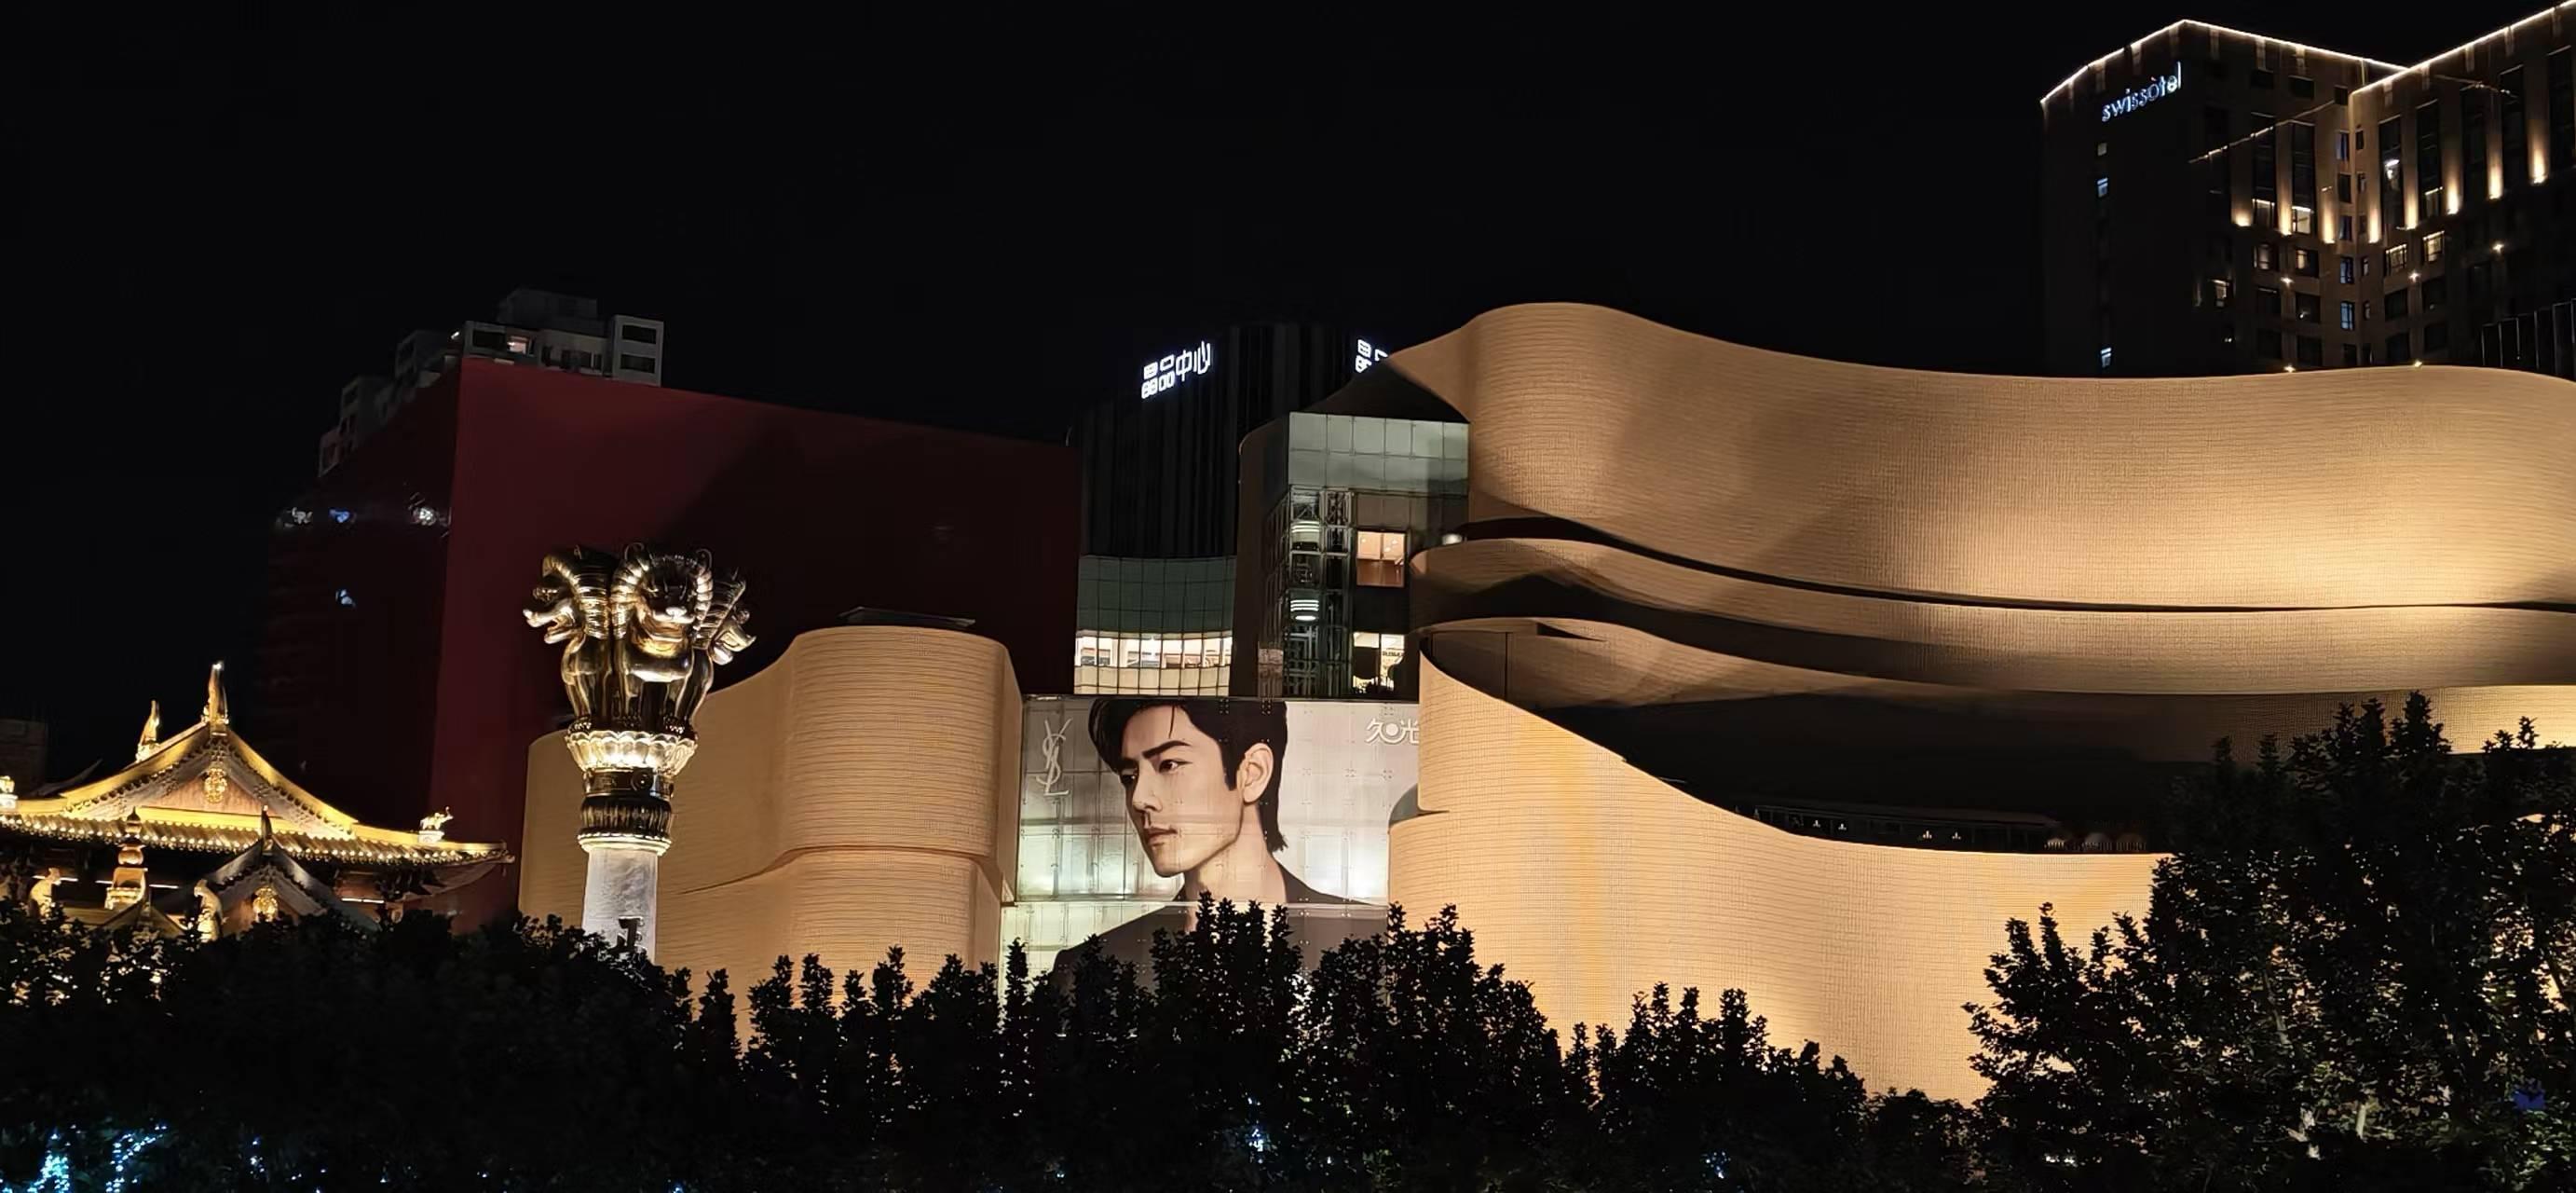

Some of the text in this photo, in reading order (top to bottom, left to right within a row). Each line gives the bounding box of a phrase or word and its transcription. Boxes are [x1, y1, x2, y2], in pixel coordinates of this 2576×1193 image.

[1141, 340, 1212, 400] 晶品中心
[1035, 717, 1073, 797] YSL
